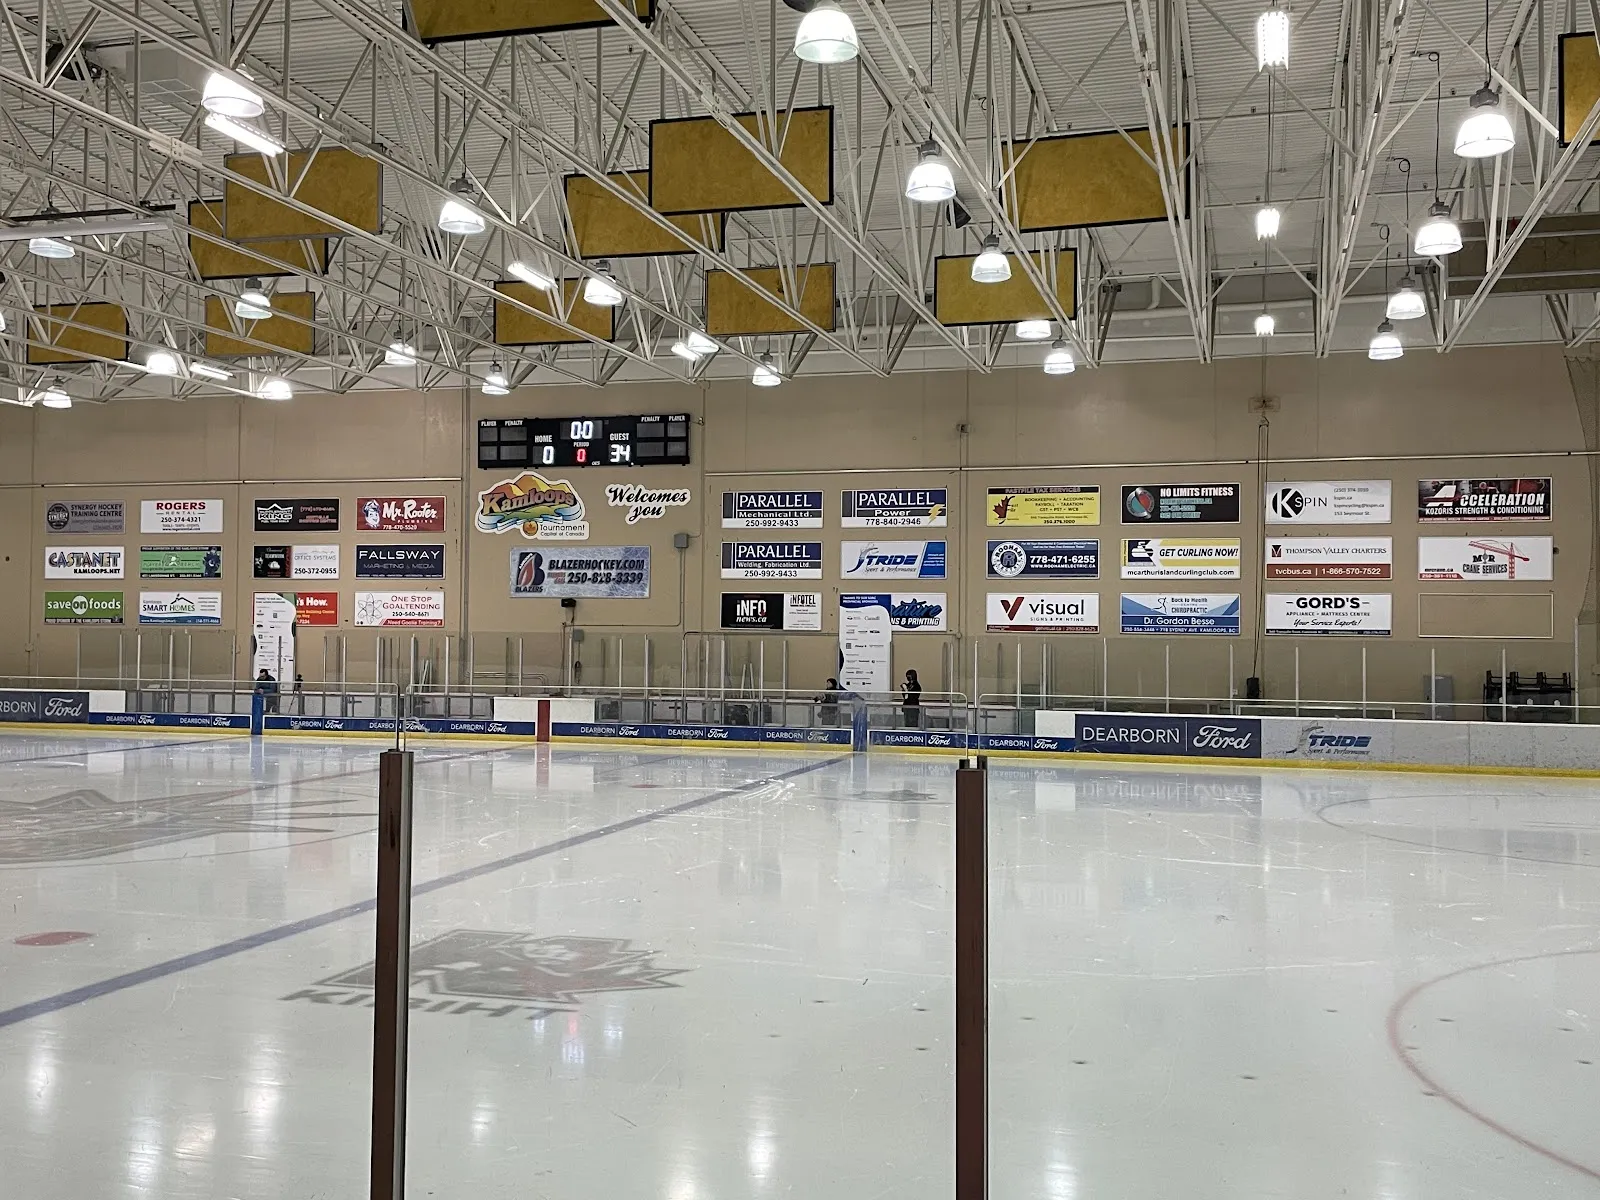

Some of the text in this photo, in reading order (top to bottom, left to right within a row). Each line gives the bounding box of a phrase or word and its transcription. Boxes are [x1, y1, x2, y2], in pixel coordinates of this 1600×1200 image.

[535, 435, 552, 443] HOME
[543, 446, 554, 464] 0
[577, 448, 586, 462] 0
[610, 444, 631, 463] 34
[609, 487, 687, 503] Welcomes
[1160, 487, 1234, 497] NO LIMITS FITNESS
[482, 488, 576, 516] Kamloops
[740, 494, 812, 508] PARALLEL
[859, 492, 935, 506] PARALLEL
[156, 502, 206, 510] ROGERS
[403, 499, 437, 519] Rooter
[1497, 506, 1544, 514] CONDITIONING
[629, 505, 662, 521] you
[874, 509, 911, 517] Power
[359, 550, 440, 560] FALLSWAY
[738, 545, 810, 558] PARALLEL
[1160, 548, 1239, 557] GET CURLING NOW!
[1322, 547, 1349, 555] VALLEY
[48, 551, 121, 568] CASTANET
[548, 559, 645, 570] BLAZERHOCKEY.COM
[1030, 555, 1096, 564] 778-471-6255
[1463, 563, 1507, 574] CRANE SERVICES
[567, 572, 643, 584] 250-828-3339
[89, 597, 121, 609] foods
[1029, 599, 1084, 615] visual
[1296, 597, 1360, 609] GORD'S
[908, 618, 940, 626] PRINTING
[1143, 617, 1215, 625] Dr. Gordon Besse
[1293, 618, 1310, 627] Your
[44, 698, 83, 716] Ford
[105, 715, 156, 725] DEARBORN Ford
[179, 716, 232, 727] DEARBORN Ford
[290, 719, 344, 729] DEARBORN Ford
[450, 722, 508, 733] DEARBORN Ford
[580, 725, 640, 736] DEARBORN Ford
[667, 727, 729, 740] DEARBORN Ford
[766, 730, 830, 742] DEARBORN Ford
[885, 734, 951, 746] DEARBORN Ford
[1082, 725, 1252, 750] DEARBORN Ford
[989, 738, 1058, 751] DEARBORN Ford
